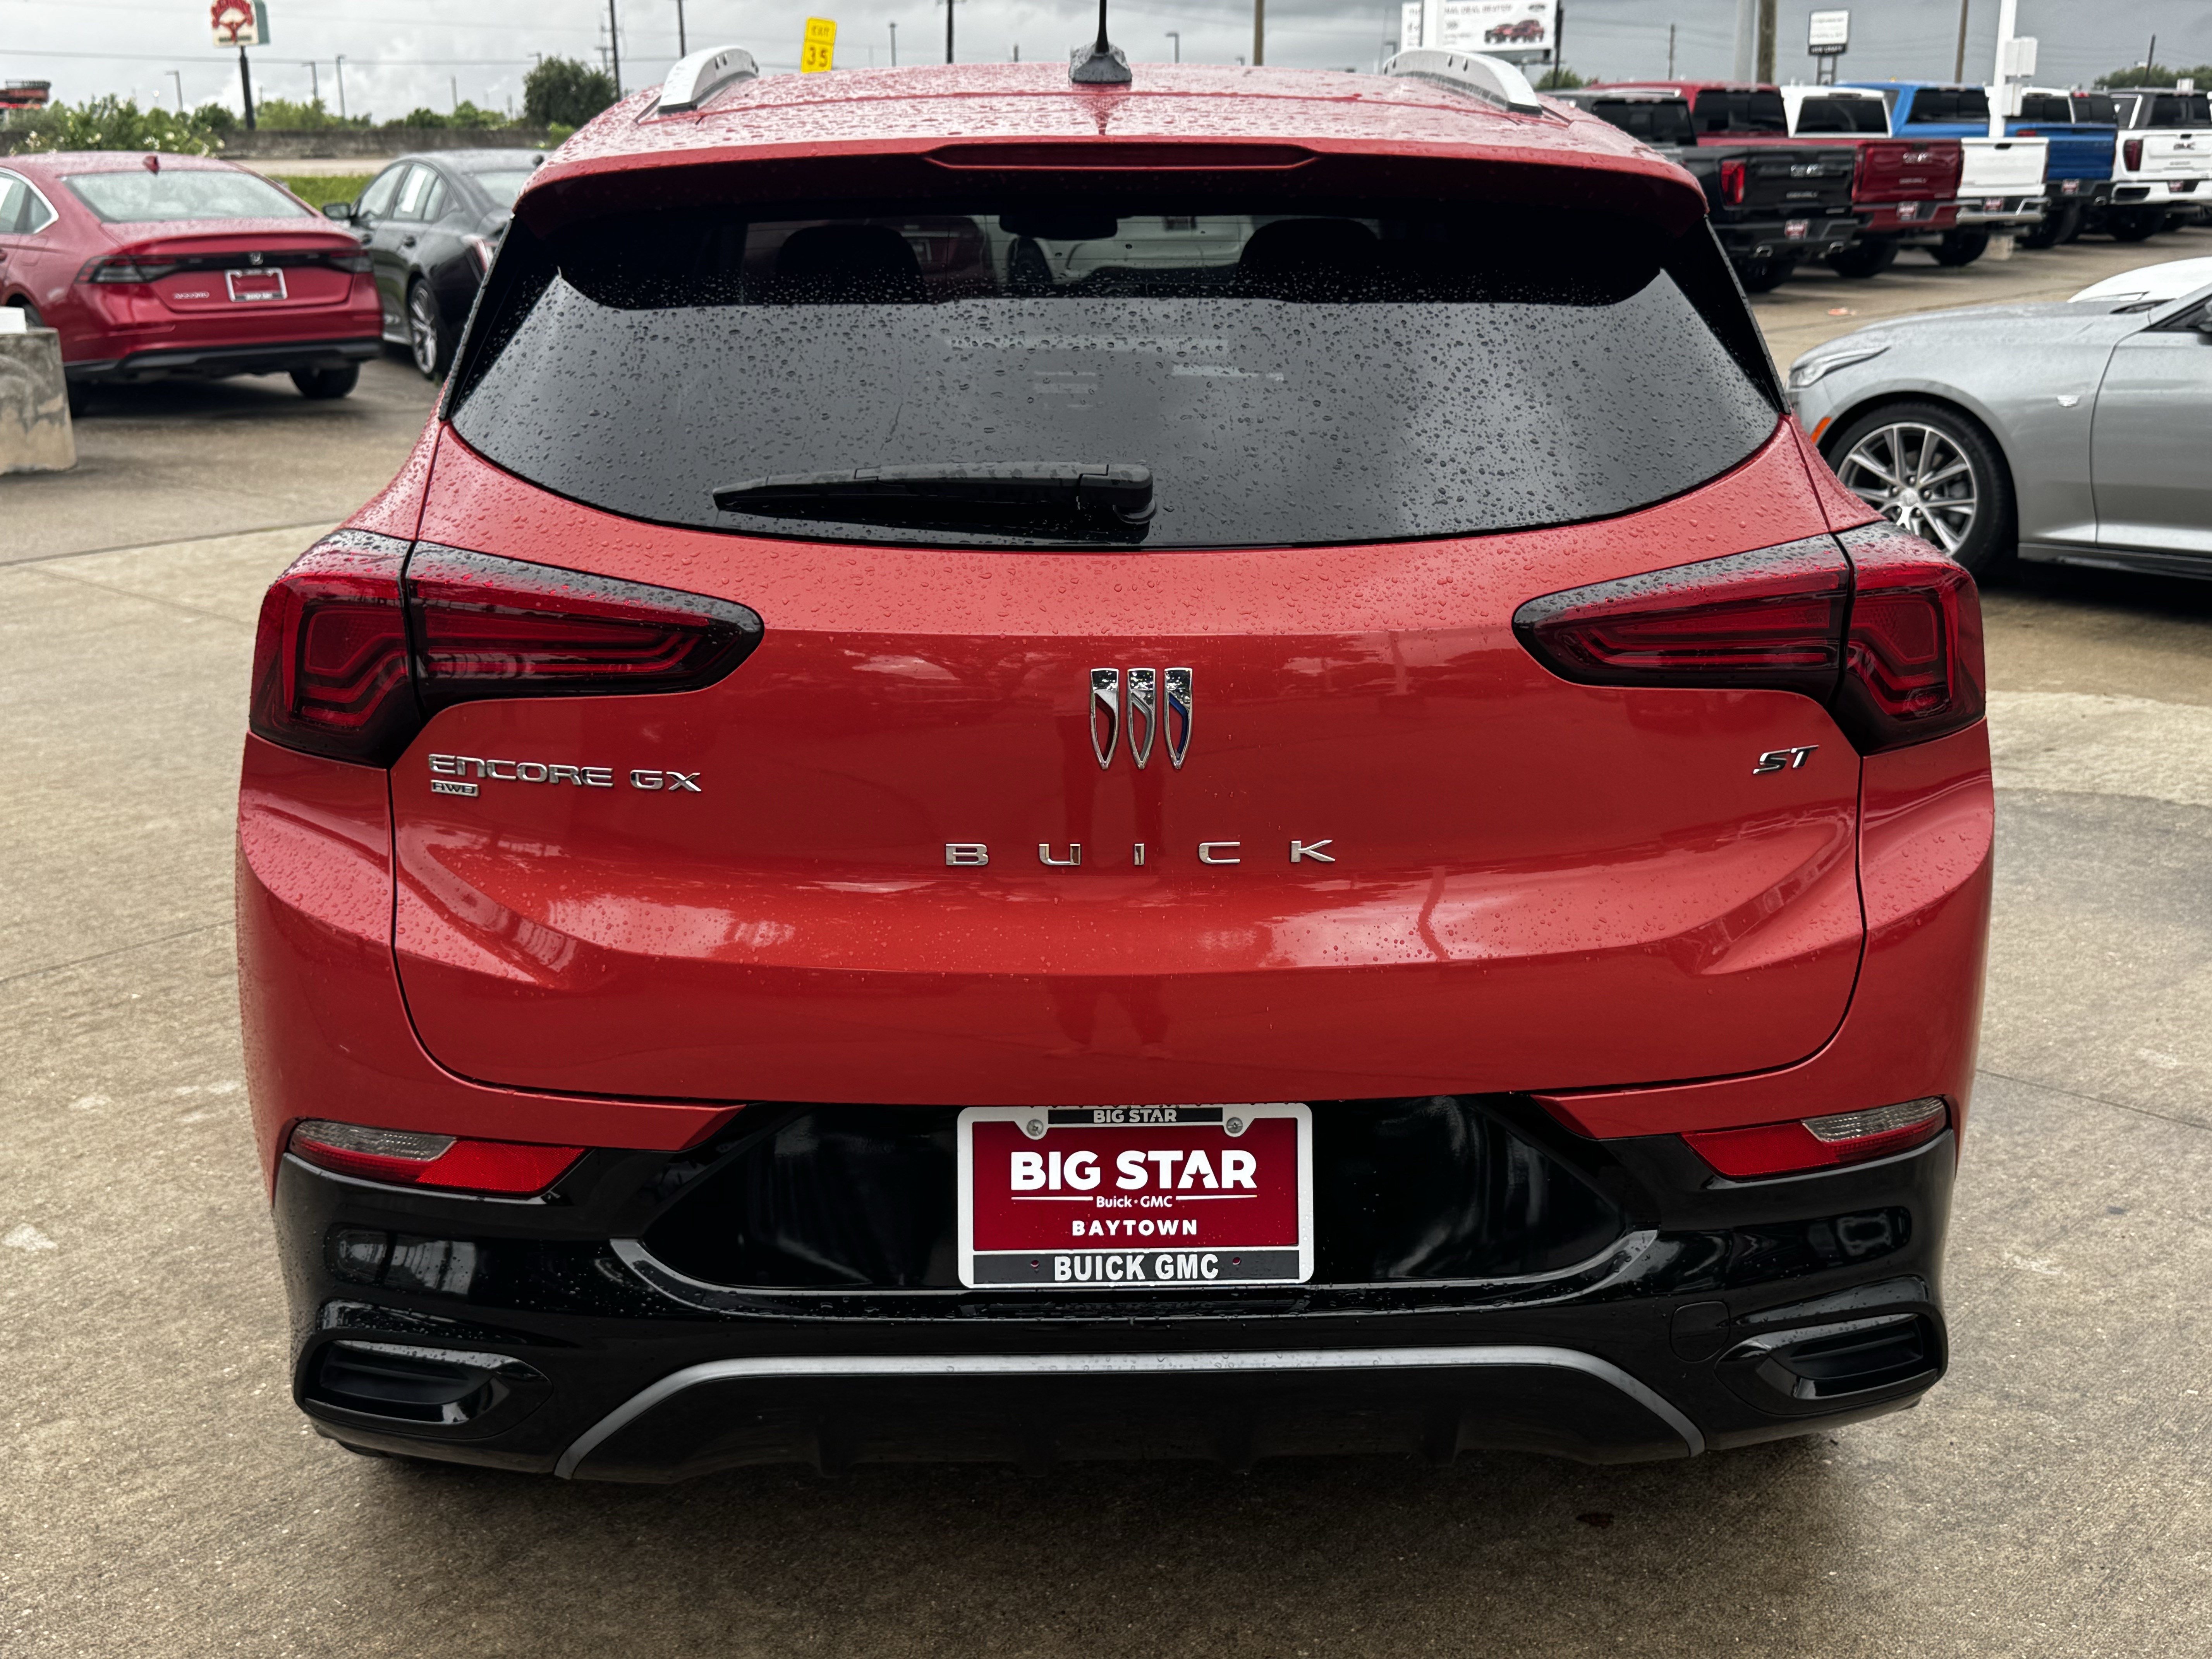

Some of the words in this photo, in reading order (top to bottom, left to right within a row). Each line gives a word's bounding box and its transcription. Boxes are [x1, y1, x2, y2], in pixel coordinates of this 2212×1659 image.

[807, 46, 828, 67] 35
[1753, 744, 1819, 775] ST
[428, 754, 614, 788] ENCORE
[630, 769, 702, 792] GX
[431, 780, 478, 796] AWD
[945, 839, 1336, 866] BUICK
[1093, 1109, 1124, 1123] BIG
[1128, 1109, 1176, 1123] STAR
[1011, 1150, 1101, 1190] BIG
[1116, 1150, 1257, 1190] STAR
[1096, 1195, 1132, 1207] Buick
[1140, 1195, 1173, 1207] GMC
[1072, 1219, 1197, 1236] BAYTOWN
[1054, 1254, 1146, 1281] BUICK
[1155, 1253, 1219, 1279] GMC
